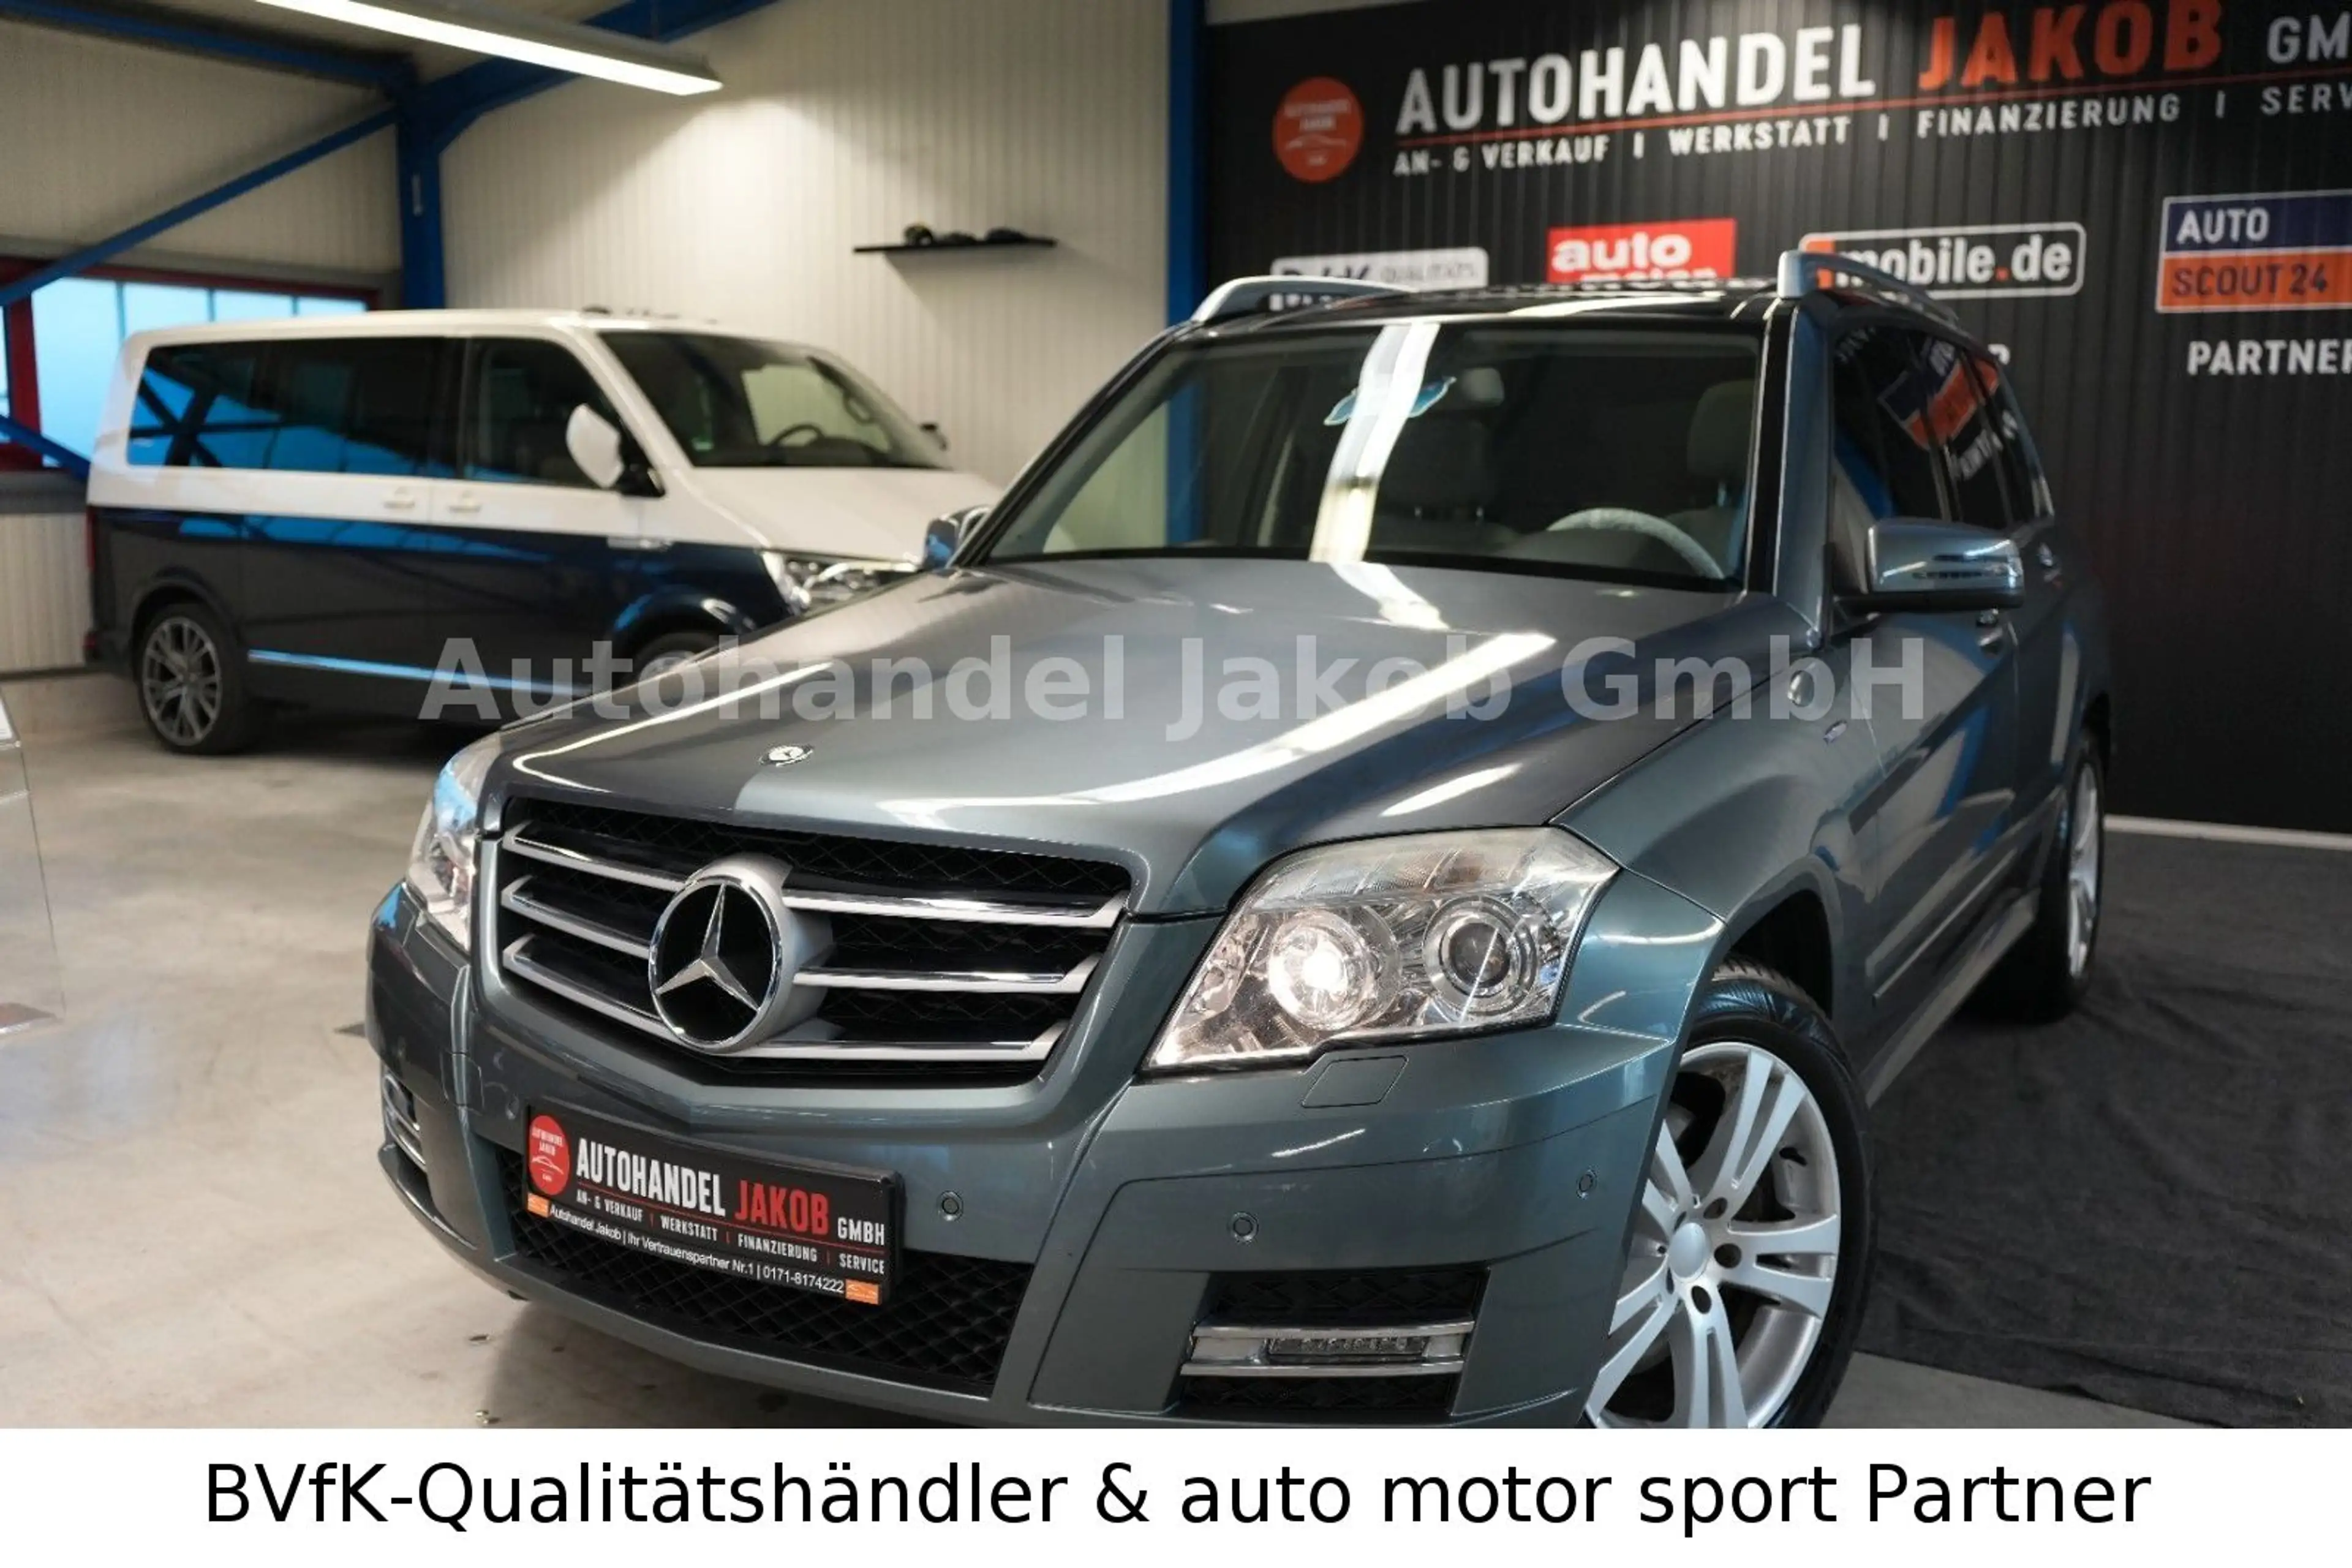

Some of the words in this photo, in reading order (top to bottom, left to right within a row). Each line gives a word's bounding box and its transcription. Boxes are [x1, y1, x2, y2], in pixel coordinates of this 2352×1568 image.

[1396, 24, 1875, 135] AUTOHANDEL
[1918, 0, 2222, 91] JAKOB
[1481, 134, 1610, 169] VERKAUF
[1668, 115, 1852, 156] WERKSTATT
[1917, 93, 2180, 139] FINANZIERUNG
[1551, 230, 1694, 273] auto
[2176, 207, 2270, 244] AUTO
[576, 1137, 726, 1217] AUTOHANDEL
[735, 1180, 829, 1235] JAKOB
[837, 1216, 885, 1246] GMBH
[550, 1204, 595, 1232] Autohandel
[595, 1221, 622, 1241] Jakob
[627, 1232, 641, 1247] Ihr
[643, 1236, 730, 1270] Vertrauenspartner
[762, 1265, 845, 1294] 0171-8174222
[603, 1198, 643, 1223] VERKAUF
[660, 1215, 718, 1242] WERKSTATT
[737, 1232, 818, 1262] FINANZIERUNG
[839, 1253, 885, 1275] SERVICE
